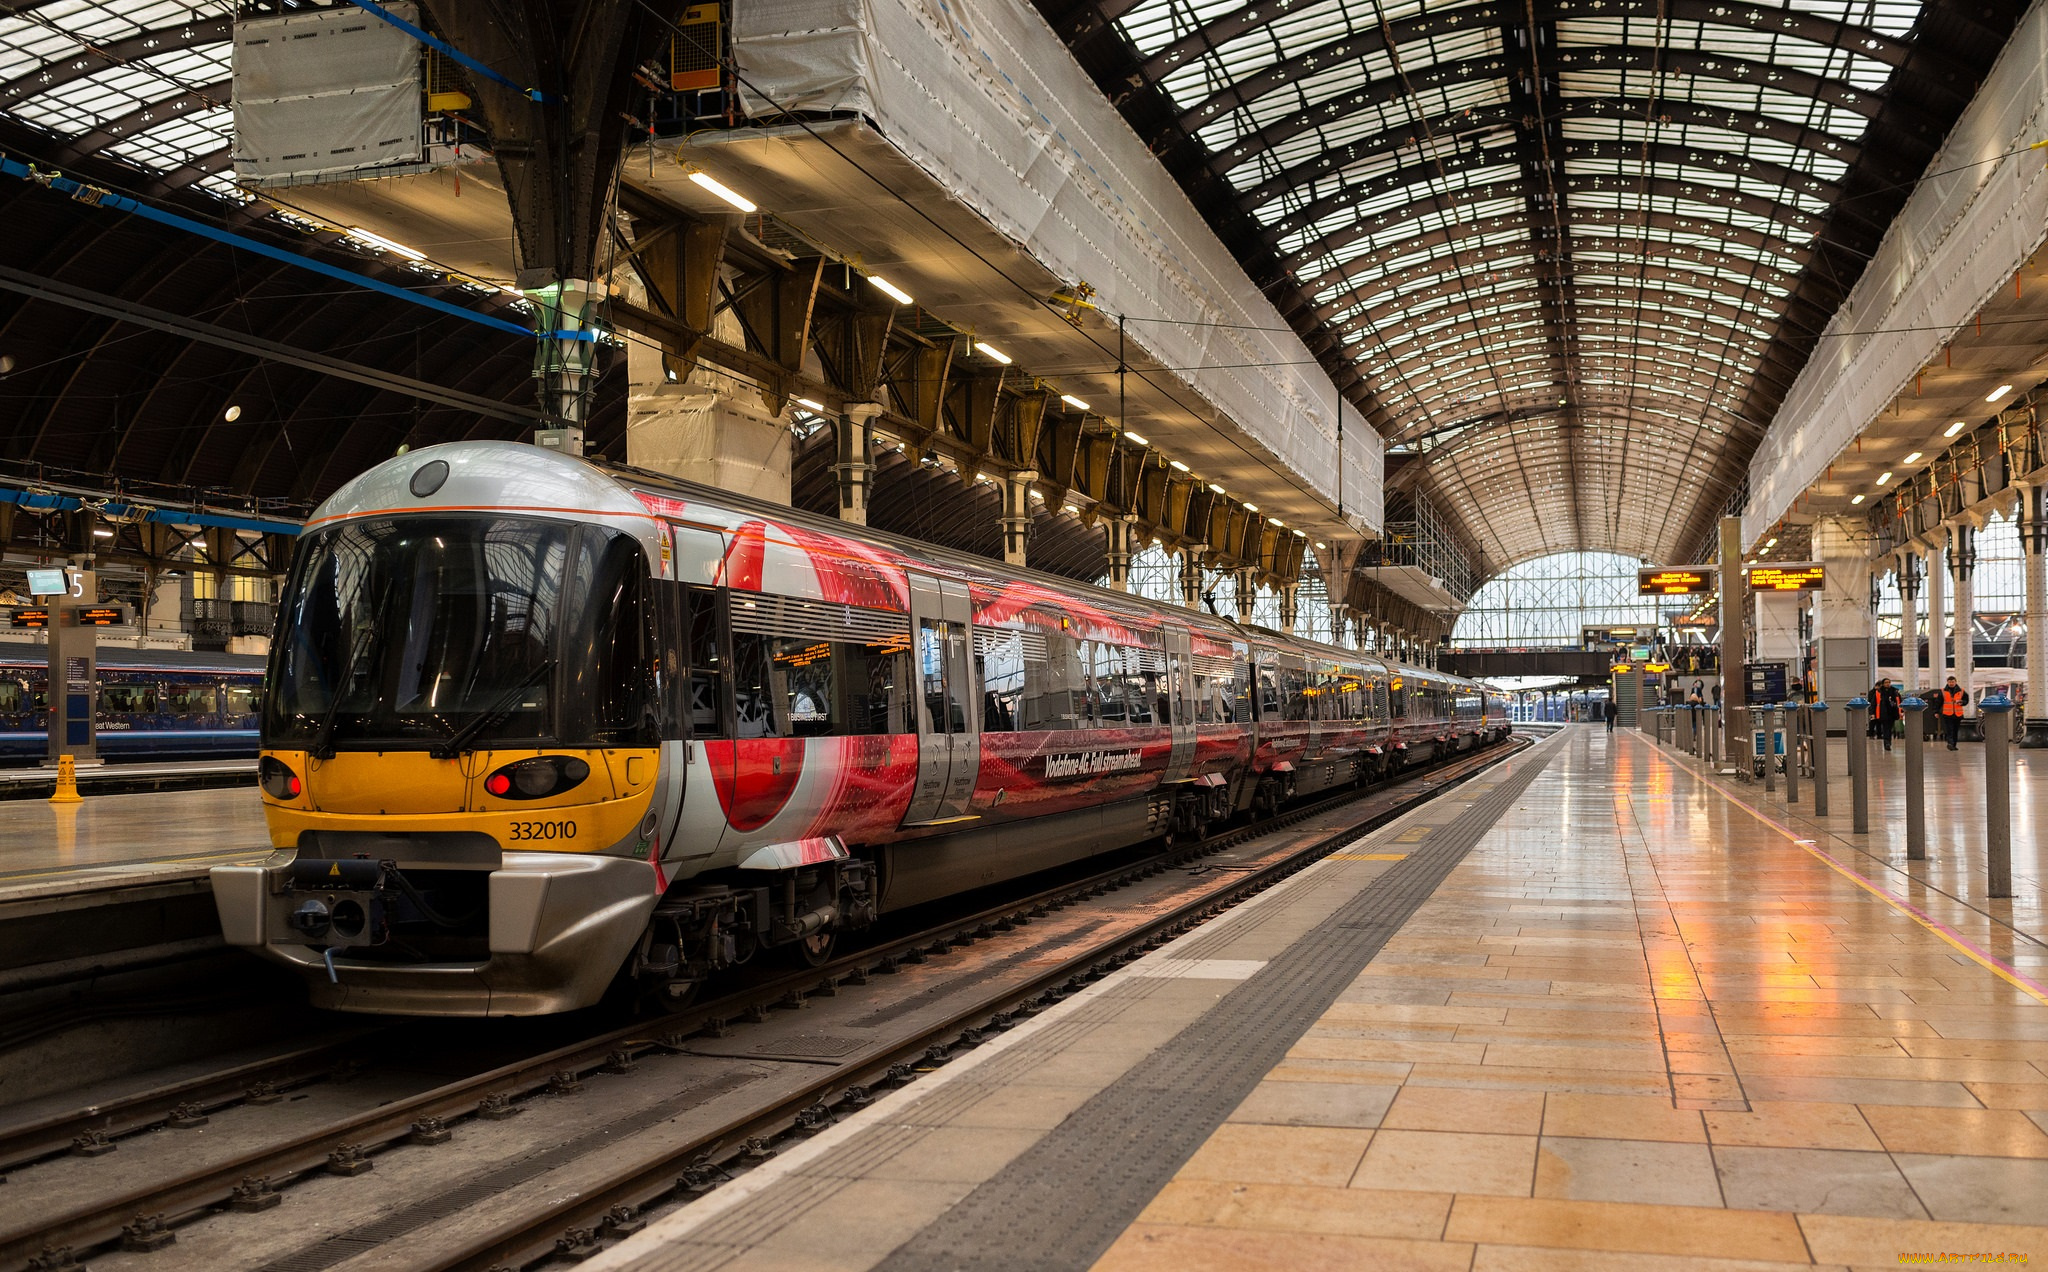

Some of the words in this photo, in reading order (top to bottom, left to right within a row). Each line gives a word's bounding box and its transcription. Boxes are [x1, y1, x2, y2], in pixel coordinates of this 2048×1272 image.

[73, 573, 83, 598] 5
[95, 722, 105, 730] eat
[105, 721, 130, 730] Western
[1045, 753, 1079, 779] Vodafone
[1079, 752, 1090, 774] 4G.
[1089, 751, 1104, 773] Full
[1102, 752, 1125, 772] stream
[1124, 748, 1143, 769] ahead.
[509, 820, 577, 840] 332010
